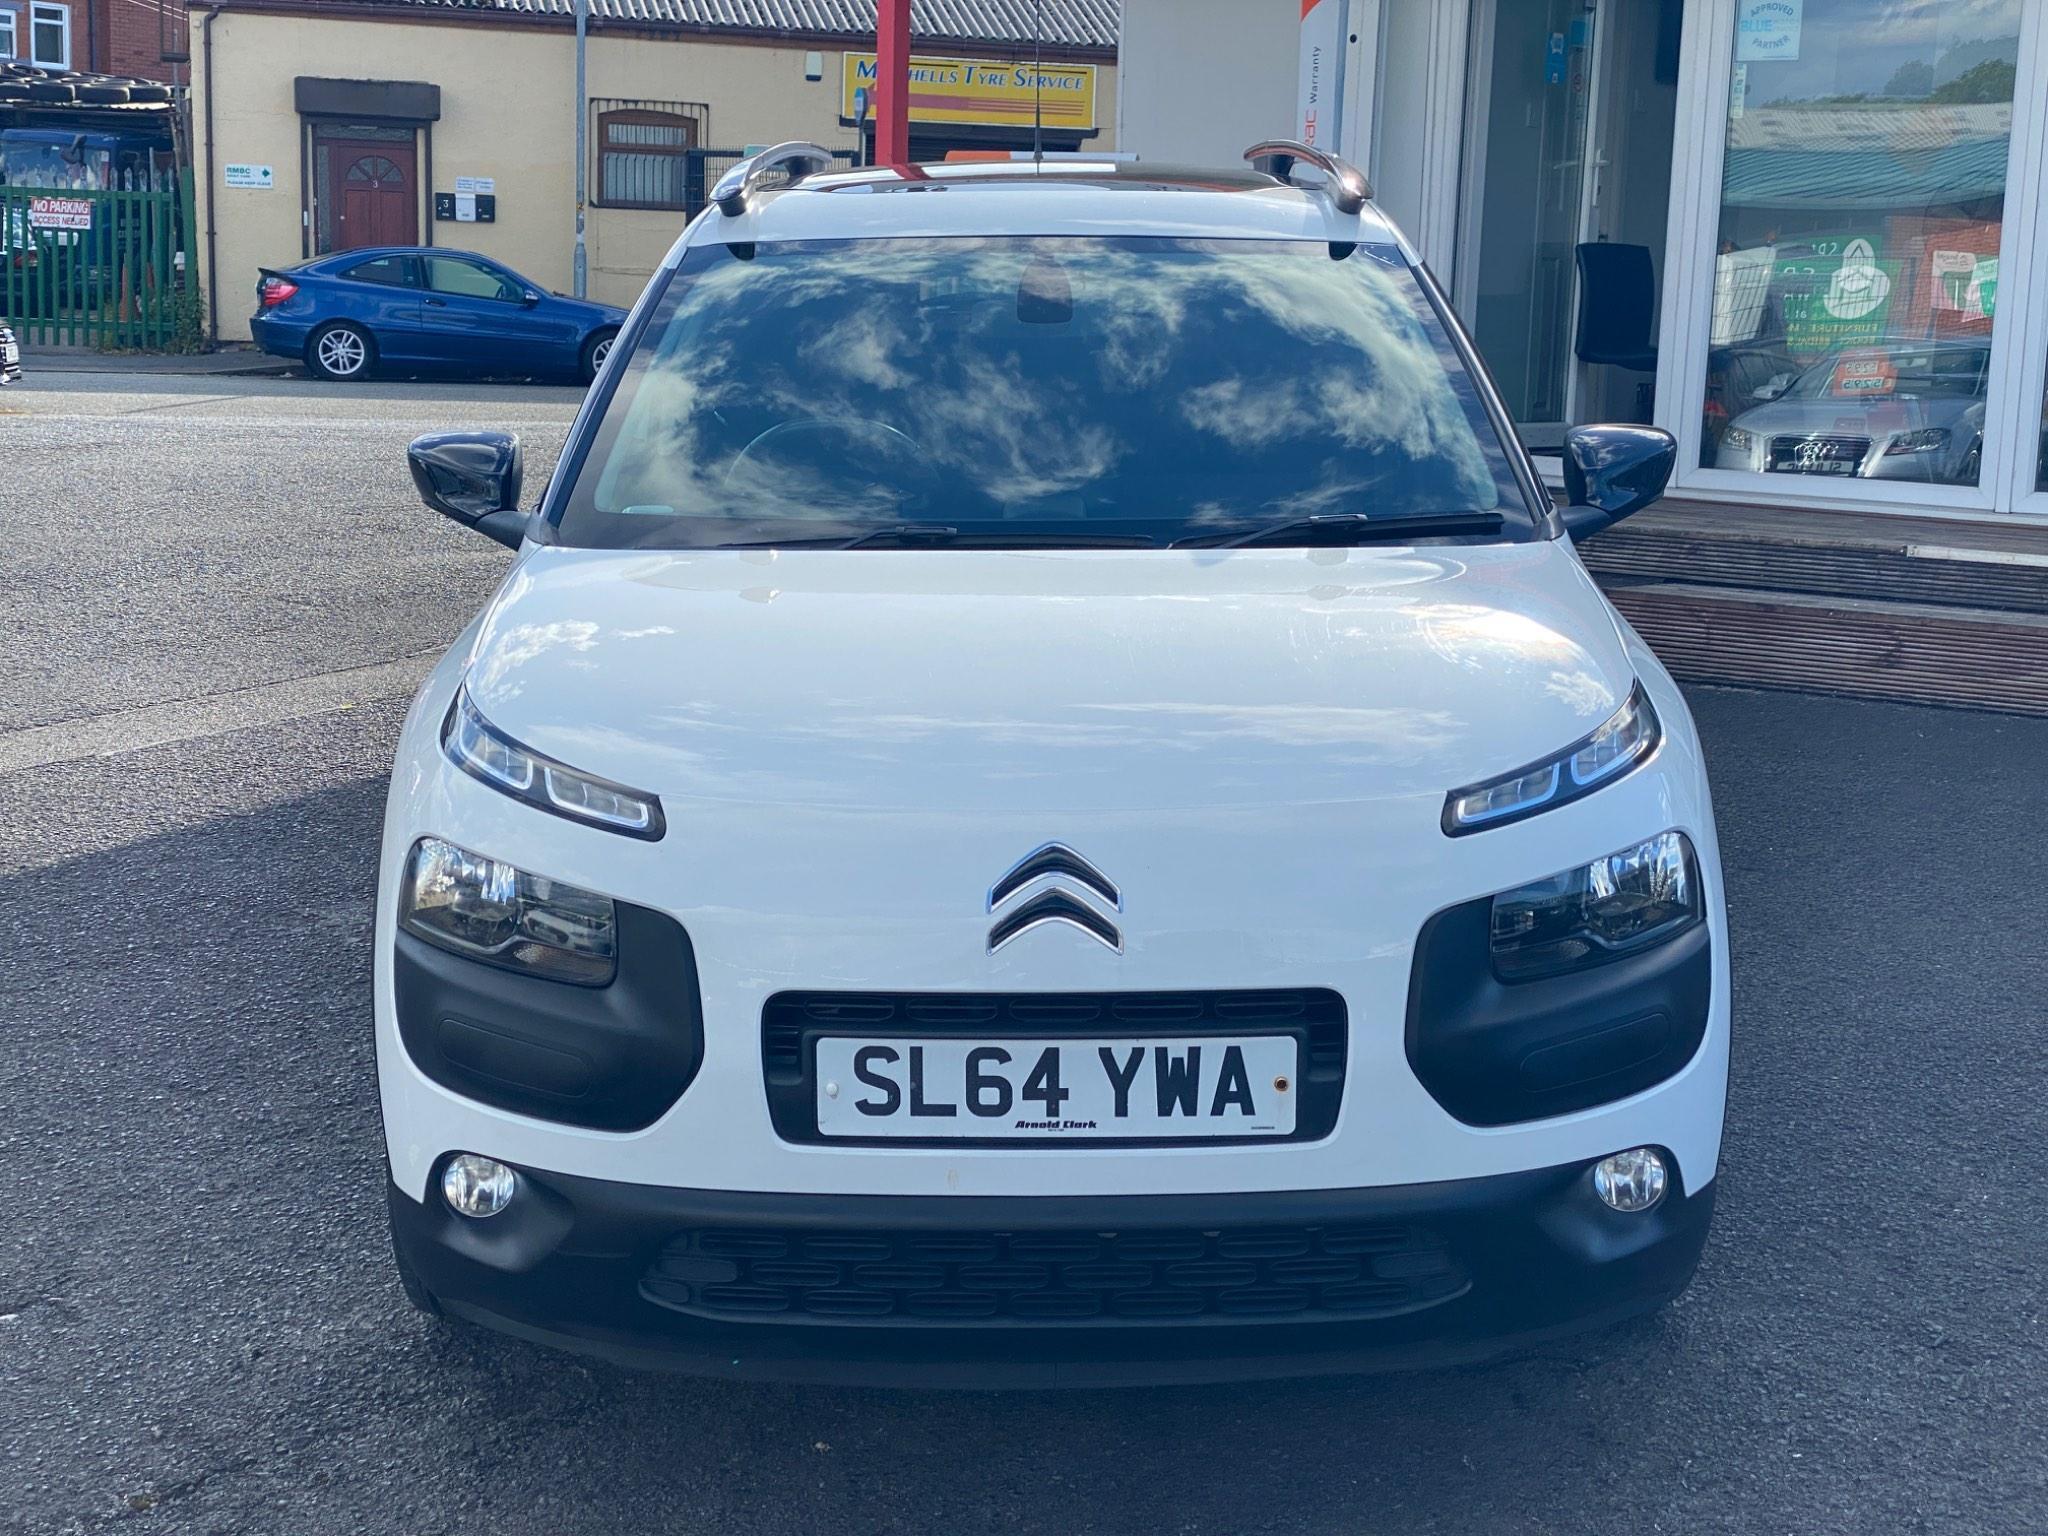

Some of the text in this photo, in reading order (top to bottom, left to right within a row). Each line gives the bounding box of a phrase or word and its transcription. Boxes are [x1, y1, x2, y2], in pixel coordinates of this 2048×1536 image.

[1750, 2, 1794, 17] APPROVED
[1740, 19, 1772, 32] BLUE
[1752, 35, 1790, 49] PARTNER
[856, 60, 1084, 90] MHELLS TYRE SERVICE
[1308, 46, 1322, 104] Warranty
[33, 199, 89, 214] NO PARKING
[443, 199, 449, 208] 3
[34, 215, 60, 225] ACCESS
[854, 1045, 1256, 1118] SL64 YWA
[1015, 1120, 1097, 1129] Arnold Clark
